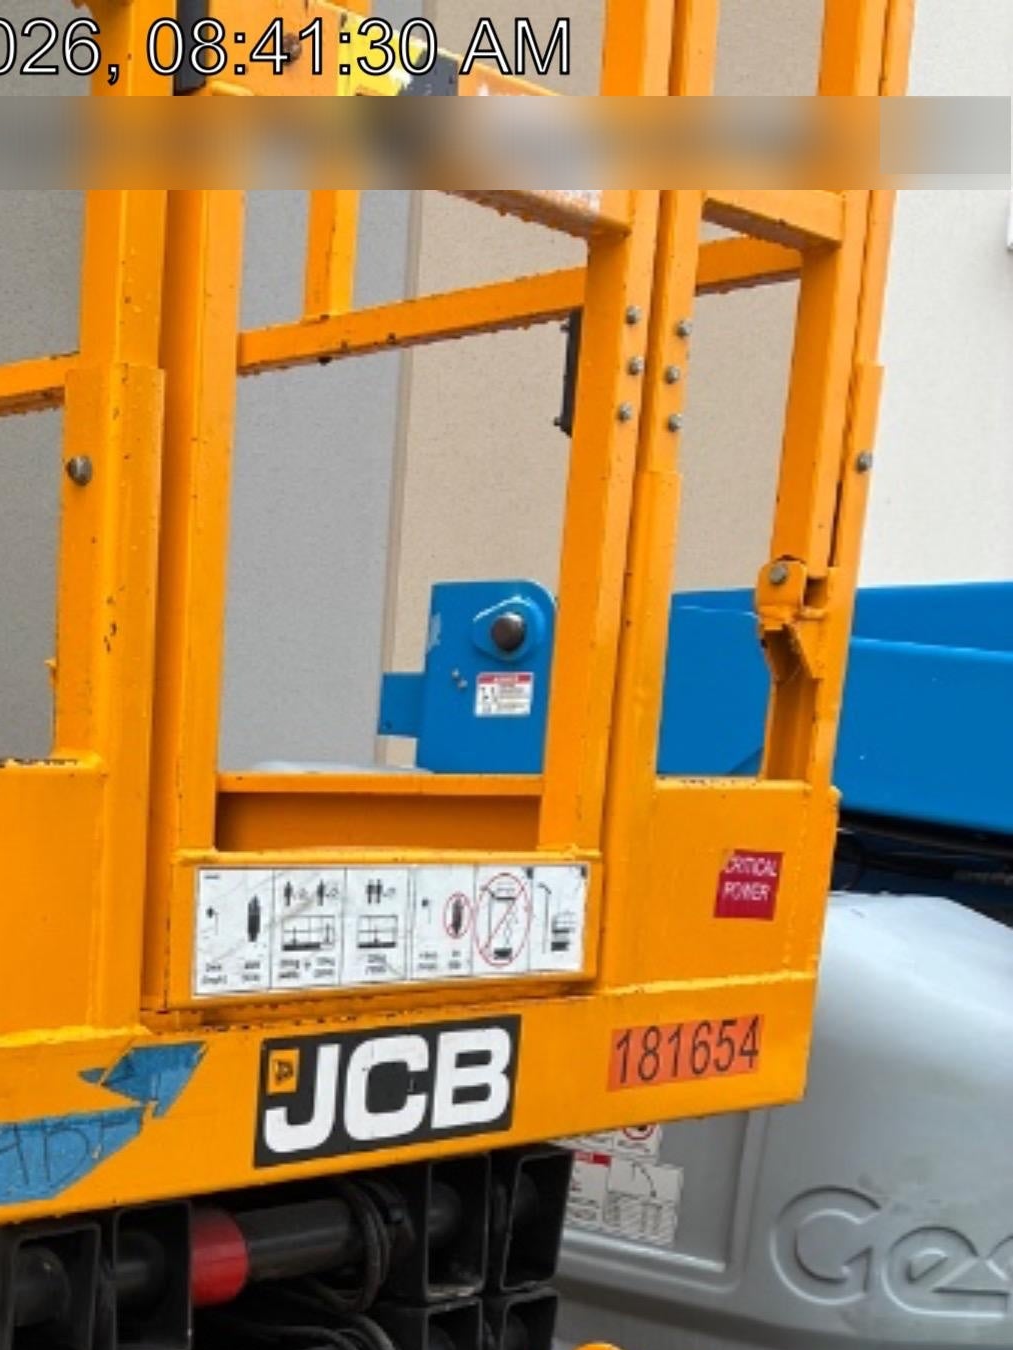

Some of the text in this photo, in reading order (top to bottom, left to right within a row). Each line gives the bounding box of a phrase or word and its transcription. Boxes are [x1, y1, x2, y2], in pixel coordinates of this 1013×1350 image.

[724, 856, 778, 877] CRITICAL
[722, 881, 771, 901] POWER
[616, 1014, 760, 1084] 181654
[263, 1027, 512, 1153] JCB
